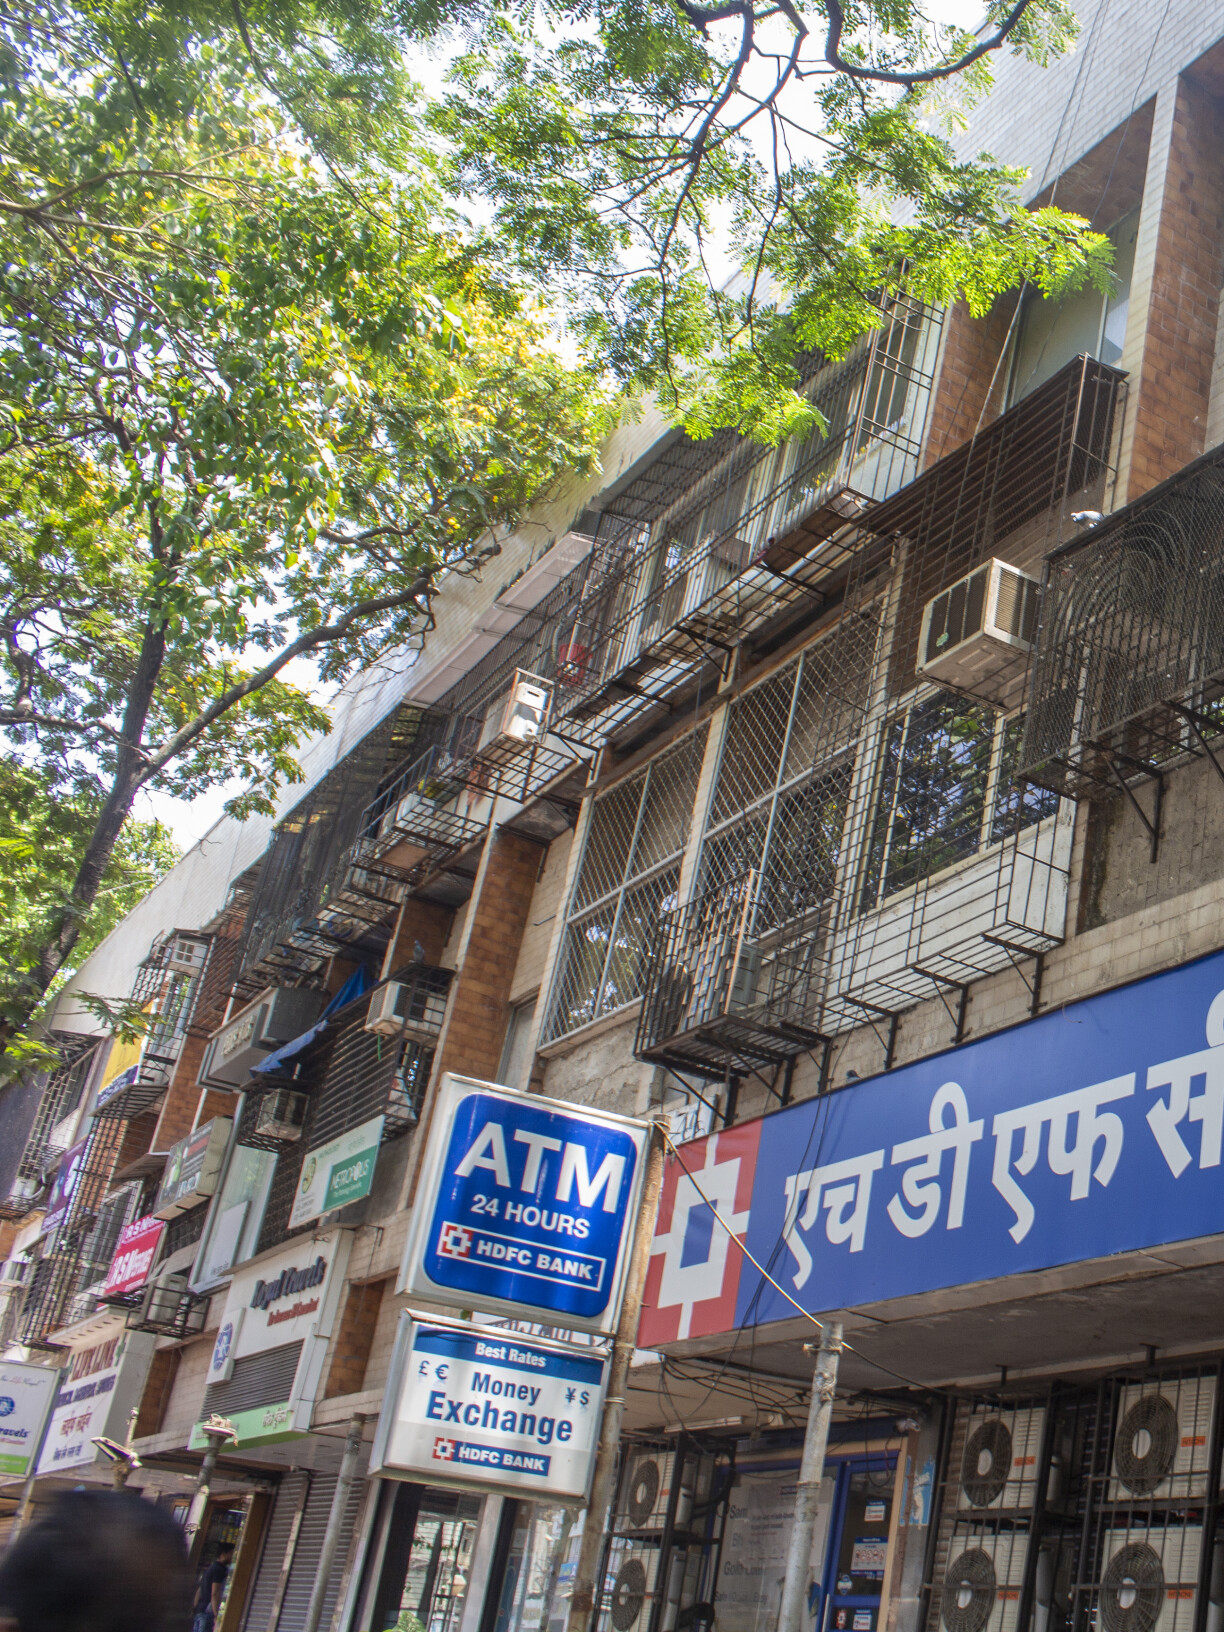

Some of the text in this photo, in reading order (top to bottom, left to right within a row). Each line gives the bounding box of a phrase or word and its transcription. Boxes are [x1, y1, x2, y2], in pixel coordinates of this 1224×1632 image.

[454, 1121, 627, 1215] ATM
[471, 1194, 590, 1239] 24 HOURS
[477, 1240, 594, 1281] HDFC BANK
[475, 1342, 547, 1368] Best Rates
[471, 1372, 541, 1407] Money
[426, 1390, 574, 1445] Exchange
[459, 1446, 545, 1472] HDFC BANK
